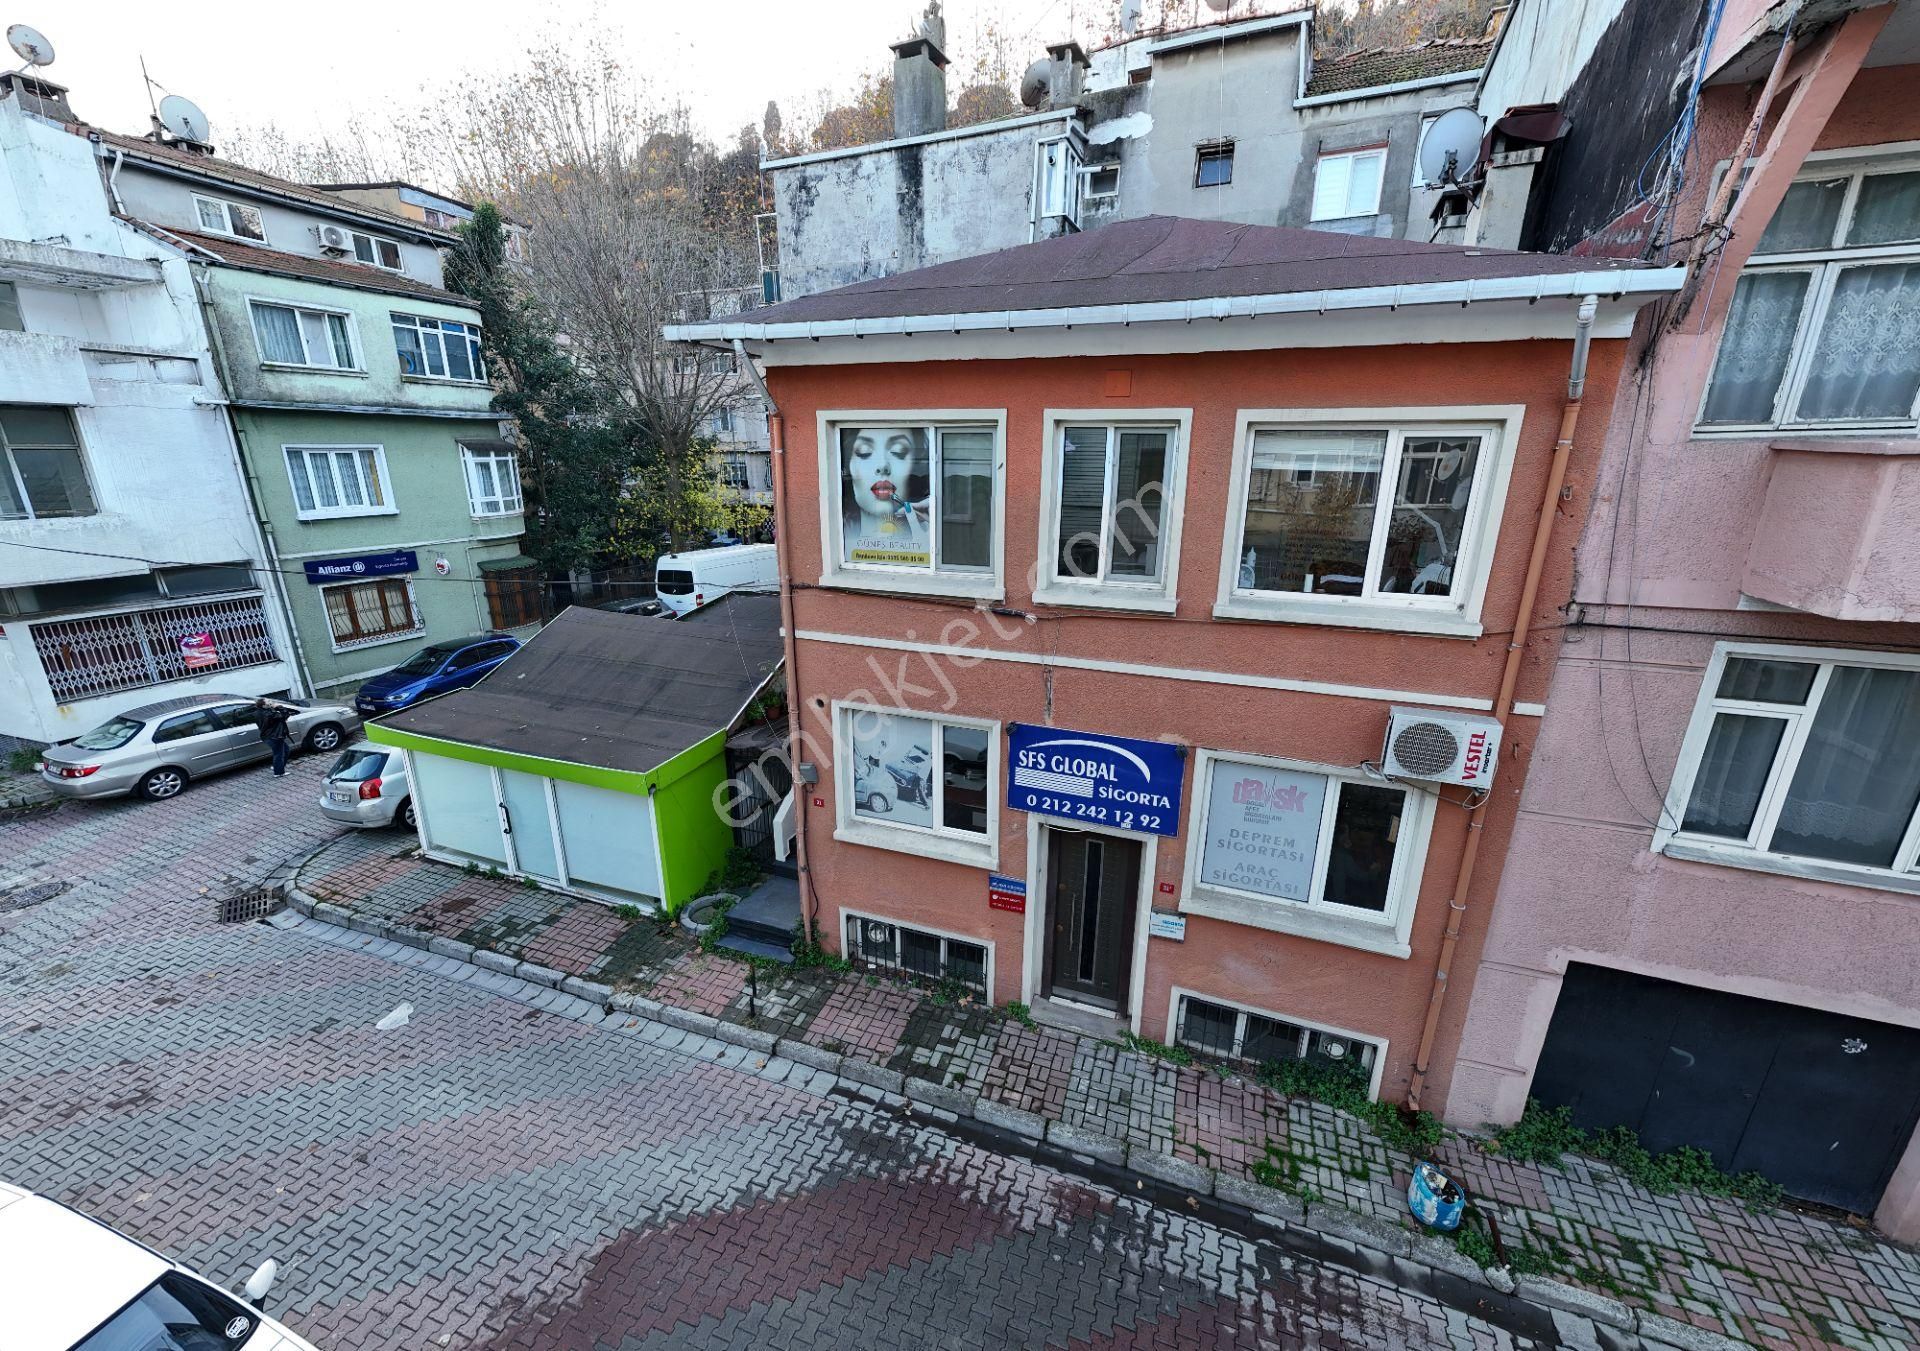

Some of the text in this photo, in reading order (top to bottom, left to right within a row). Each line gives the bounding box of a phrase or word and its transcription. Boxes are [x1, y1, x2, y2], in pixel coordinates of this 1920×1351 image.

[318, 565, 352, 575] Allianz
[1018, 749, 1118, 782] SFS GLOBAL
[1461, 731, 1487, 780] VESTEL
[1098, 784, 1171, 809] SİGORTA
[1026, 794, 1161, 829] 0 212 242 12 92
[1217, 838, 1305, 863] SİGORTASI
[1229, 828, 1296, 849] DEPREM
[1234, 861, 1279, 880] ARAÇ
